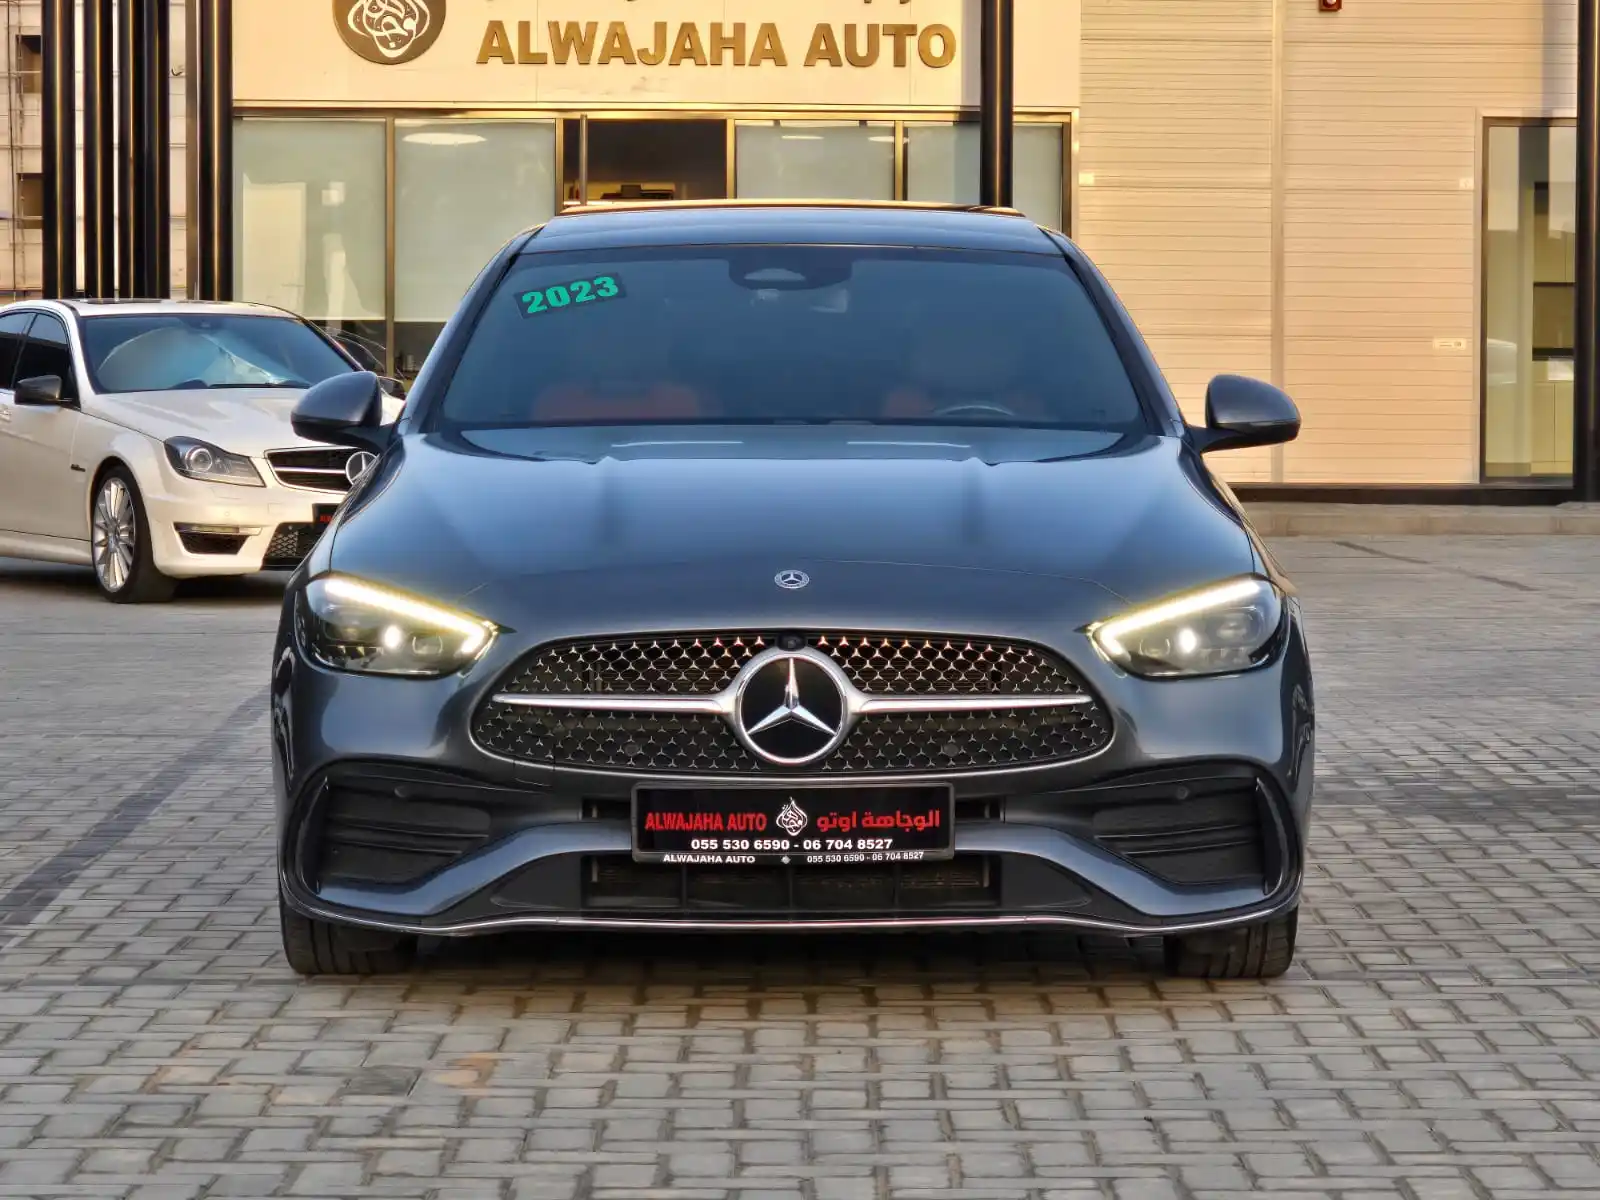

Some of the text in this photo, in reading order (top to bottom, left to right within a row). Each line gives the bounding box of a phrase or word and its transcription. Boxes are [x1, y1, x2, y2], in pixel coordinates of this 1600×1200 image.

[476, 20, 788, 66] ALWAJAHA
[803, 23, 957, 68] AUTO
[522, 276, 618, 314] 2023
[645, 812, 767, 831] ALWAJAHA AUTO
[816, 809, 940, 832] الوجاهة اوتو
[691, 839, 718, 850] 055
[722, 839, 750, 850] 530
[753, 839, 790, 850] 6590
[803, 839, 821, 850] 06
[826, 839, 853, 850] 704
[857, 838, 893, 850] 8527
[663, 854, 756, 863] ALWAJAHA AUTO
[807, 855, 823, 863] 055
[825, 855, 841, 863] 530
[843, 854, 865, 862] 6590
[872, 853, 883, 861] 06
[885, 852, 901, 861] 704
[903, 851, 924, 860] 8527
